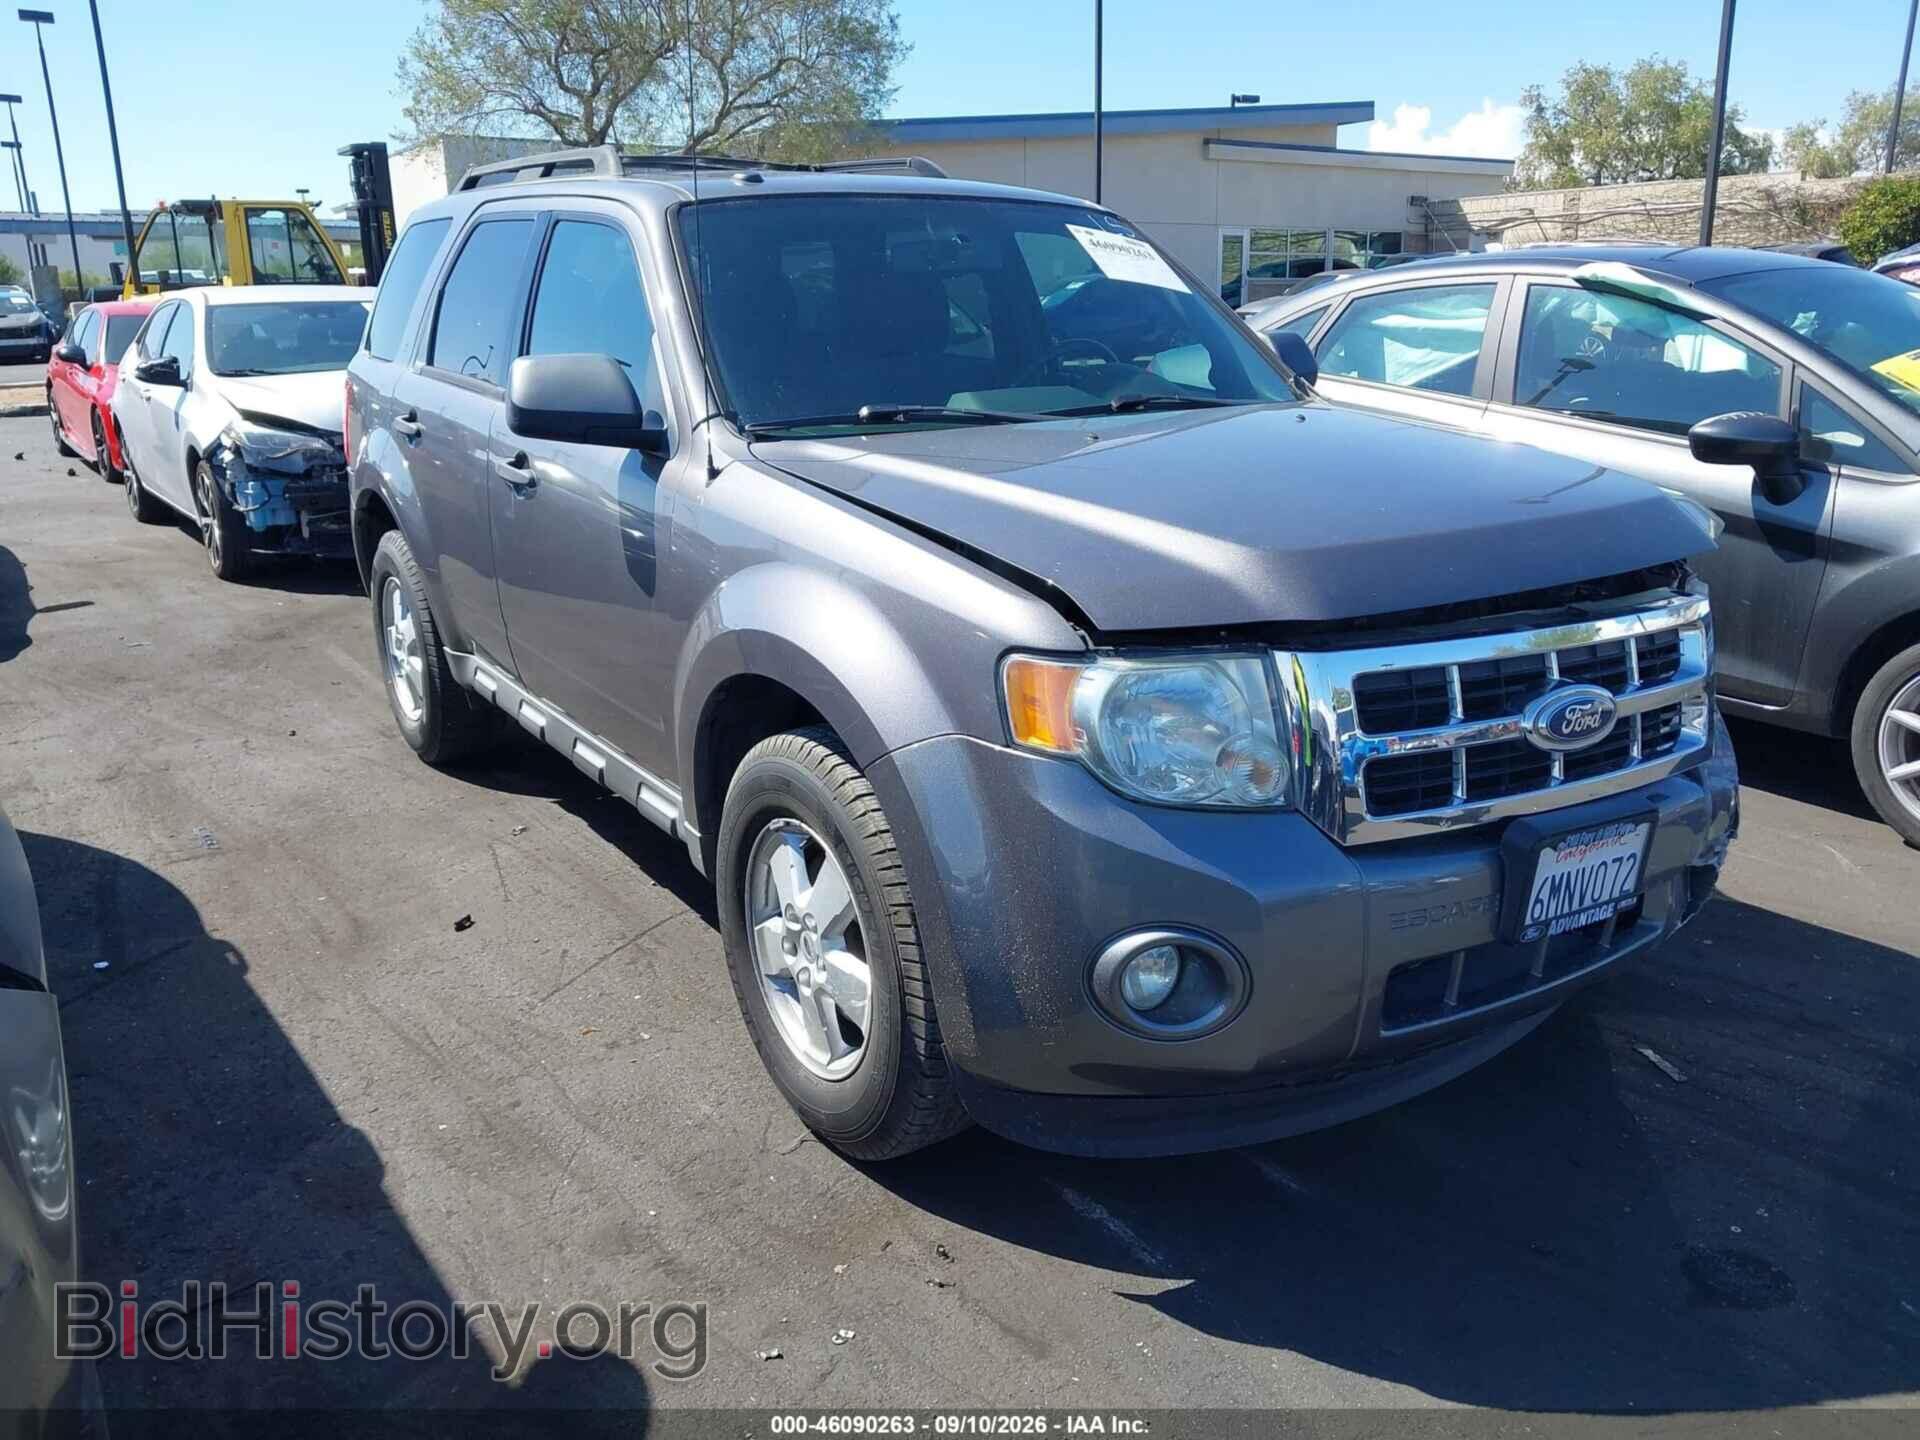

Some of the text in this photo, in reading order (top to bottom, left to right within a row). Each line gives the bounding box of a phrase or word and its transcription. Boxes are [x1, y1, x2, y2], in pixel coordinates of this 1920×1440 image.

[1562, 703, 1602, 734] Ford
[1531, 852, 1637, 923] 6MNV072
[1548, 902, 1616, 936] ADVANTAGE
